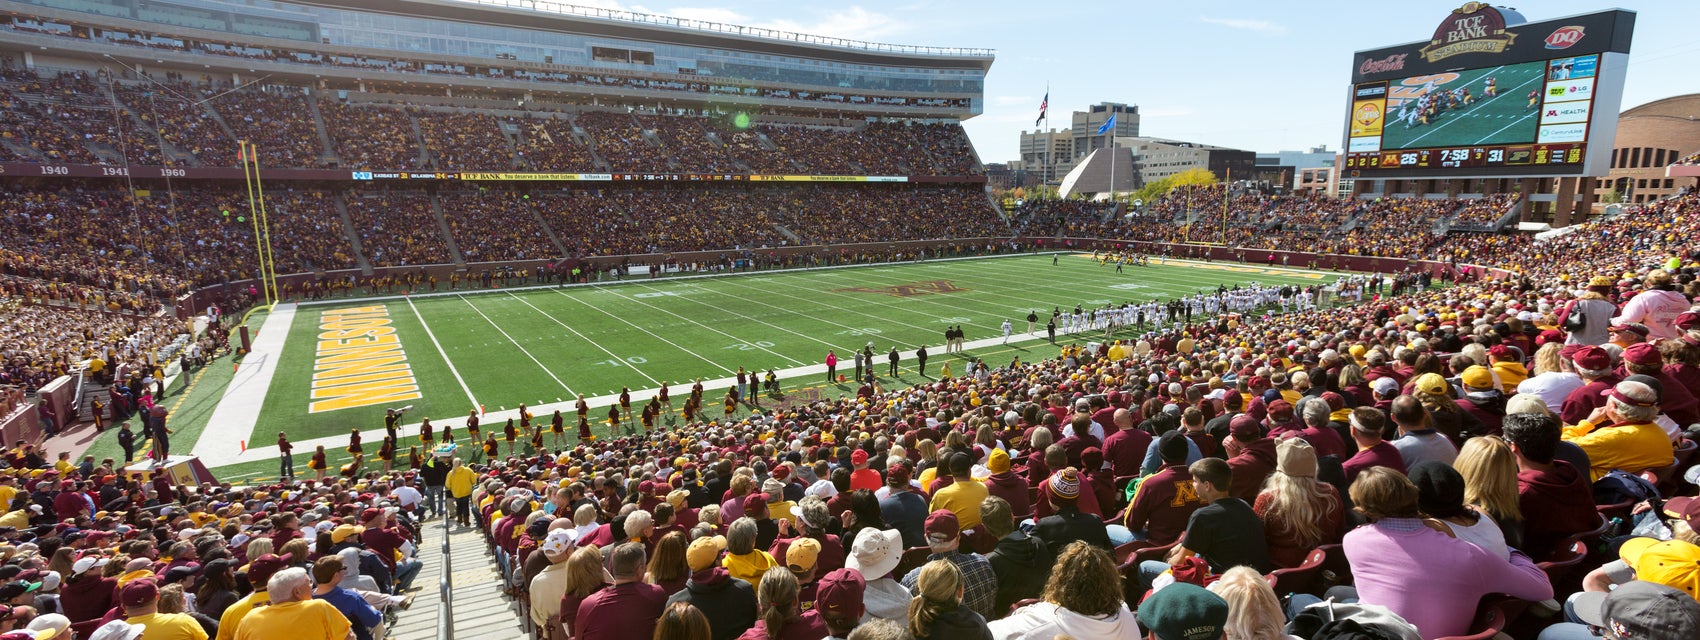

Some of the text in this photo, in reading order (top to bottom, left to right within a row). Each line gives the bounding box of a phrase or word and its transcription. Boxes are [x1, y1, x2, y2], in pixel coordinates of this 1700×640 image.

[1455, 15, 1485, 31] TCF
[1446, 25, 1488, 43] BANK
[1551, 30, 1578, 45] DQ
[1434, 40, 1498, 59] STADIUM
[1370, 157, 1378, 166] 2
[1400, 153, 1418, 165] 26
[1440, 149, 1469, 162] 7:58
[1487, 149, 1504, 162] 31
[1347, 158, 1355, 167] 3
[1359, 158, 1366, 166] 2
[40, 165, 69, 175] 1940
[102, 167, 129, 176] 1941
[160, 168, 186, 177] 1960
[308, 304, 423, 414] MINNESOTA
[1183, 625, 1215, 637] JAMESON
